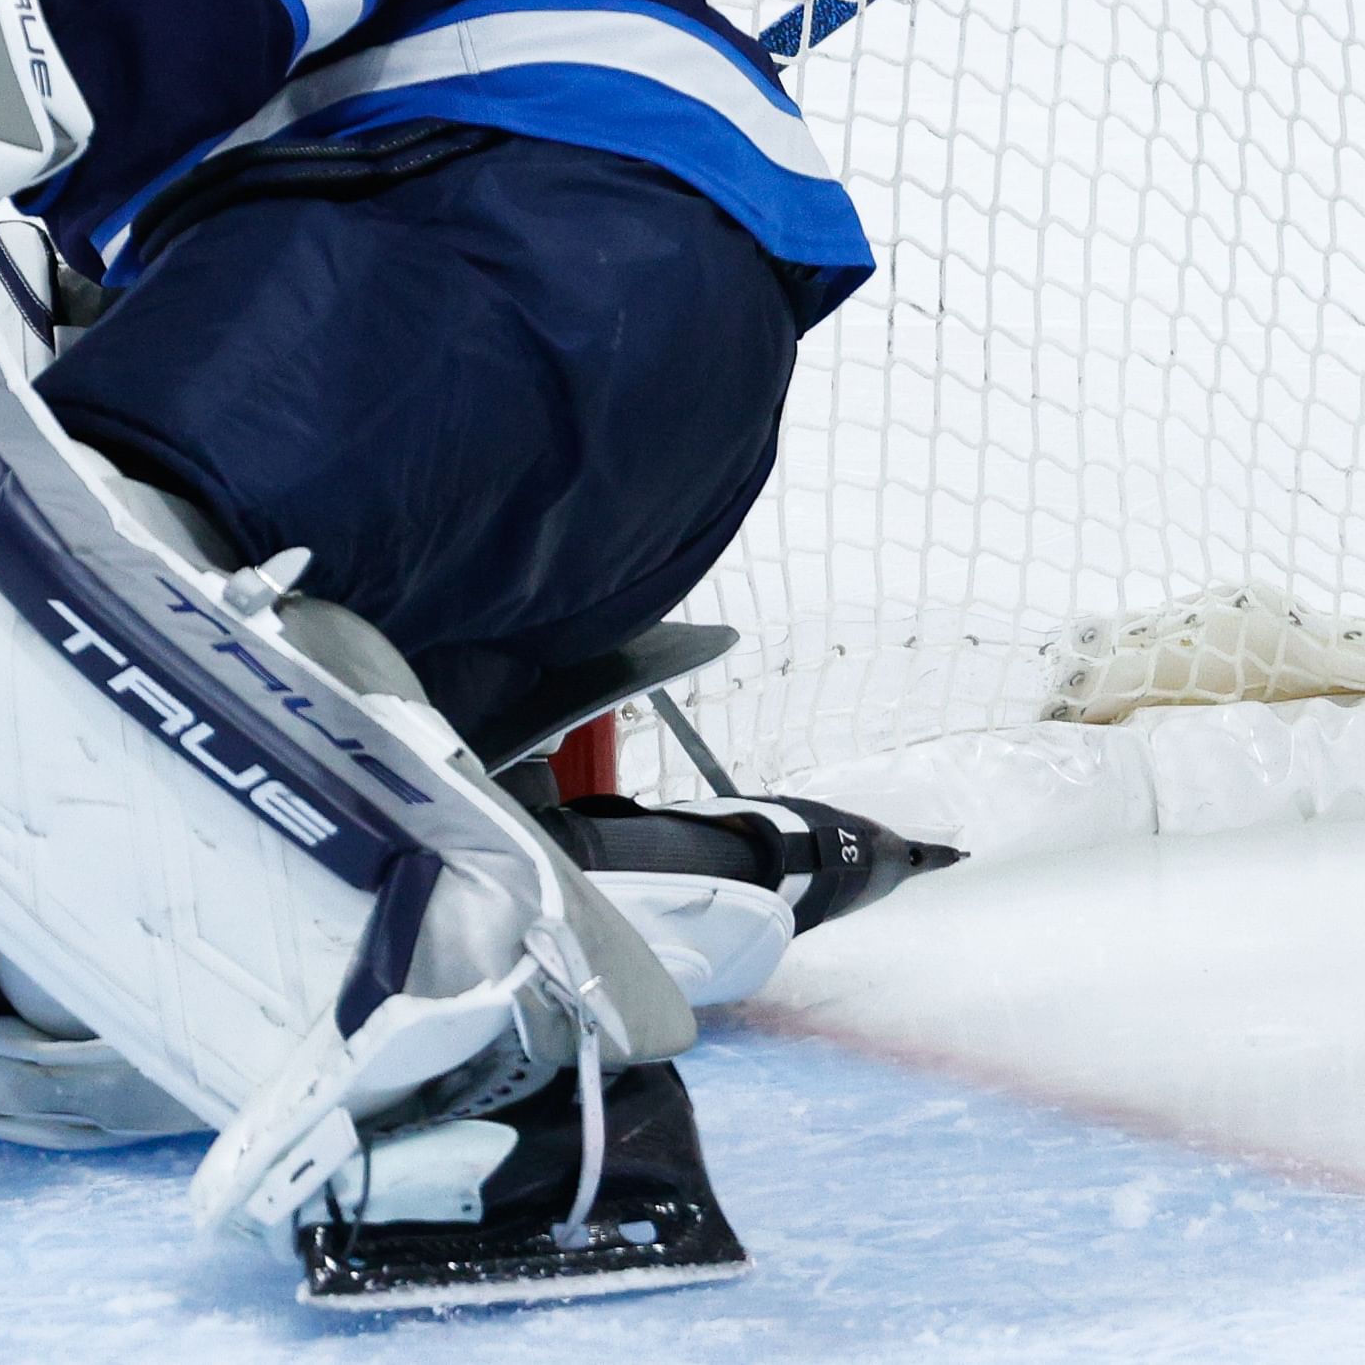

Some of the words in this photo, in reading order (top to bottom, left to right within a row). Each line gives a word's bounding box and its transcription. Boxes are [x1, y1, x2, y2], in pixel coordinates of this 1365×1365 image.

[46, 598, 342, 848] TRUE
[155, 575, 438, 806] TRUE
[837, 827, 860, 865] 37
